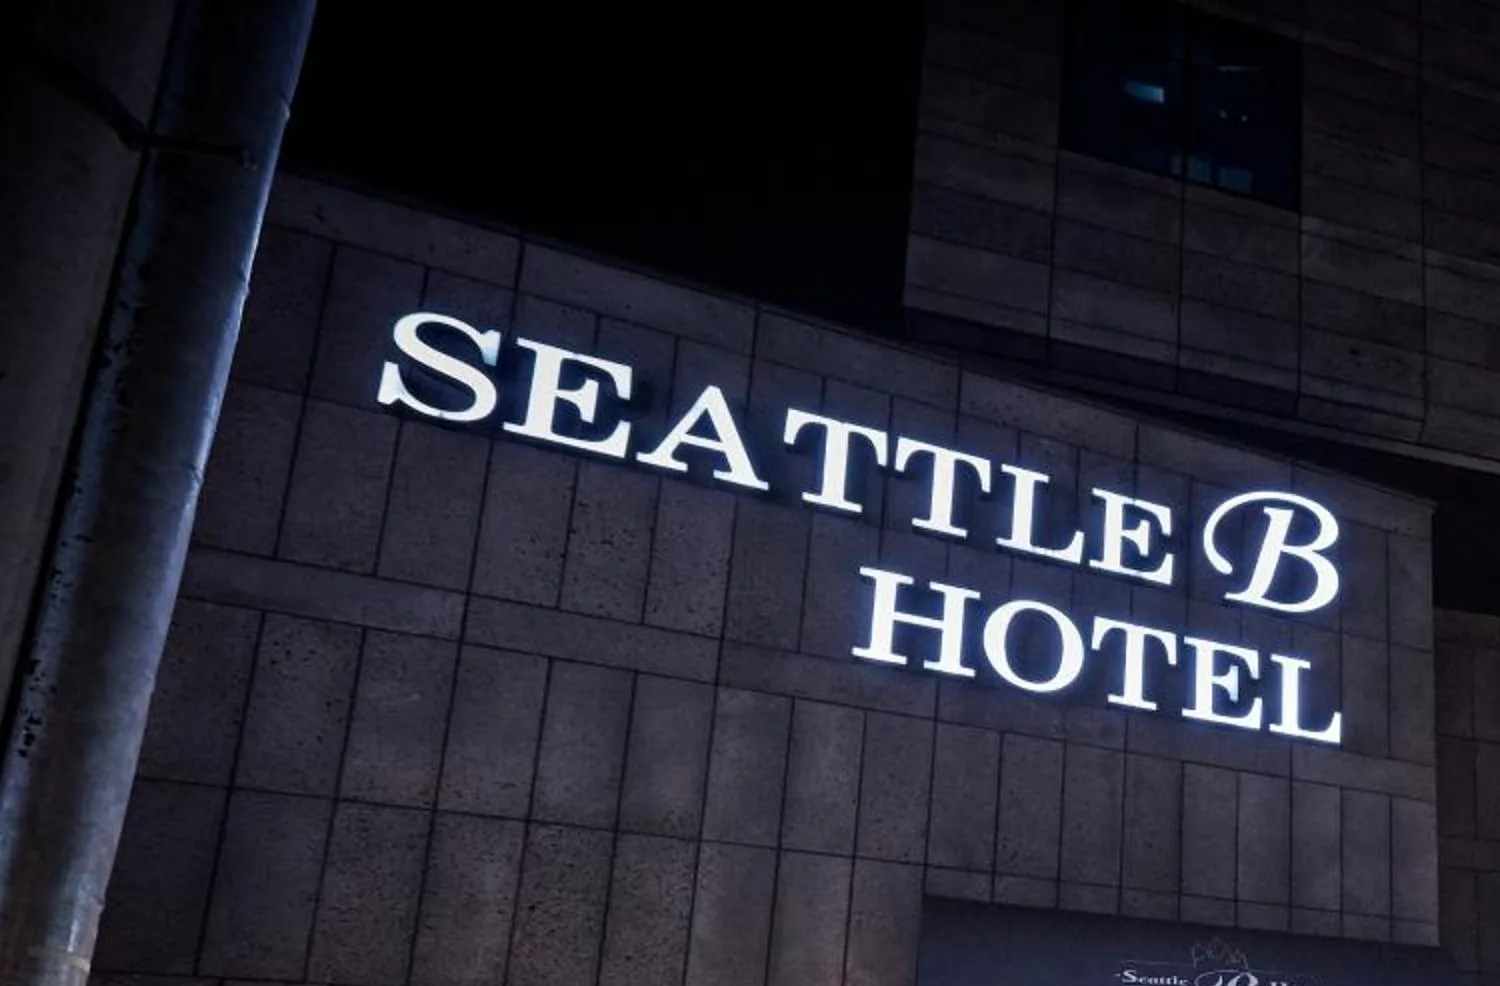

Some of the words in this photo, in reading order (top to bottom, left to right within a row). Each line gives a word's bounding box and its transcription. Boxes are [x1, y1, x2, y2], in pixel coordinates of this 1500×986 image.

[377, 312, 1175, 586] SEATTLE
[1202, 490, 1341, 614] B
[851, 565, 1343, 745] HOTEL
